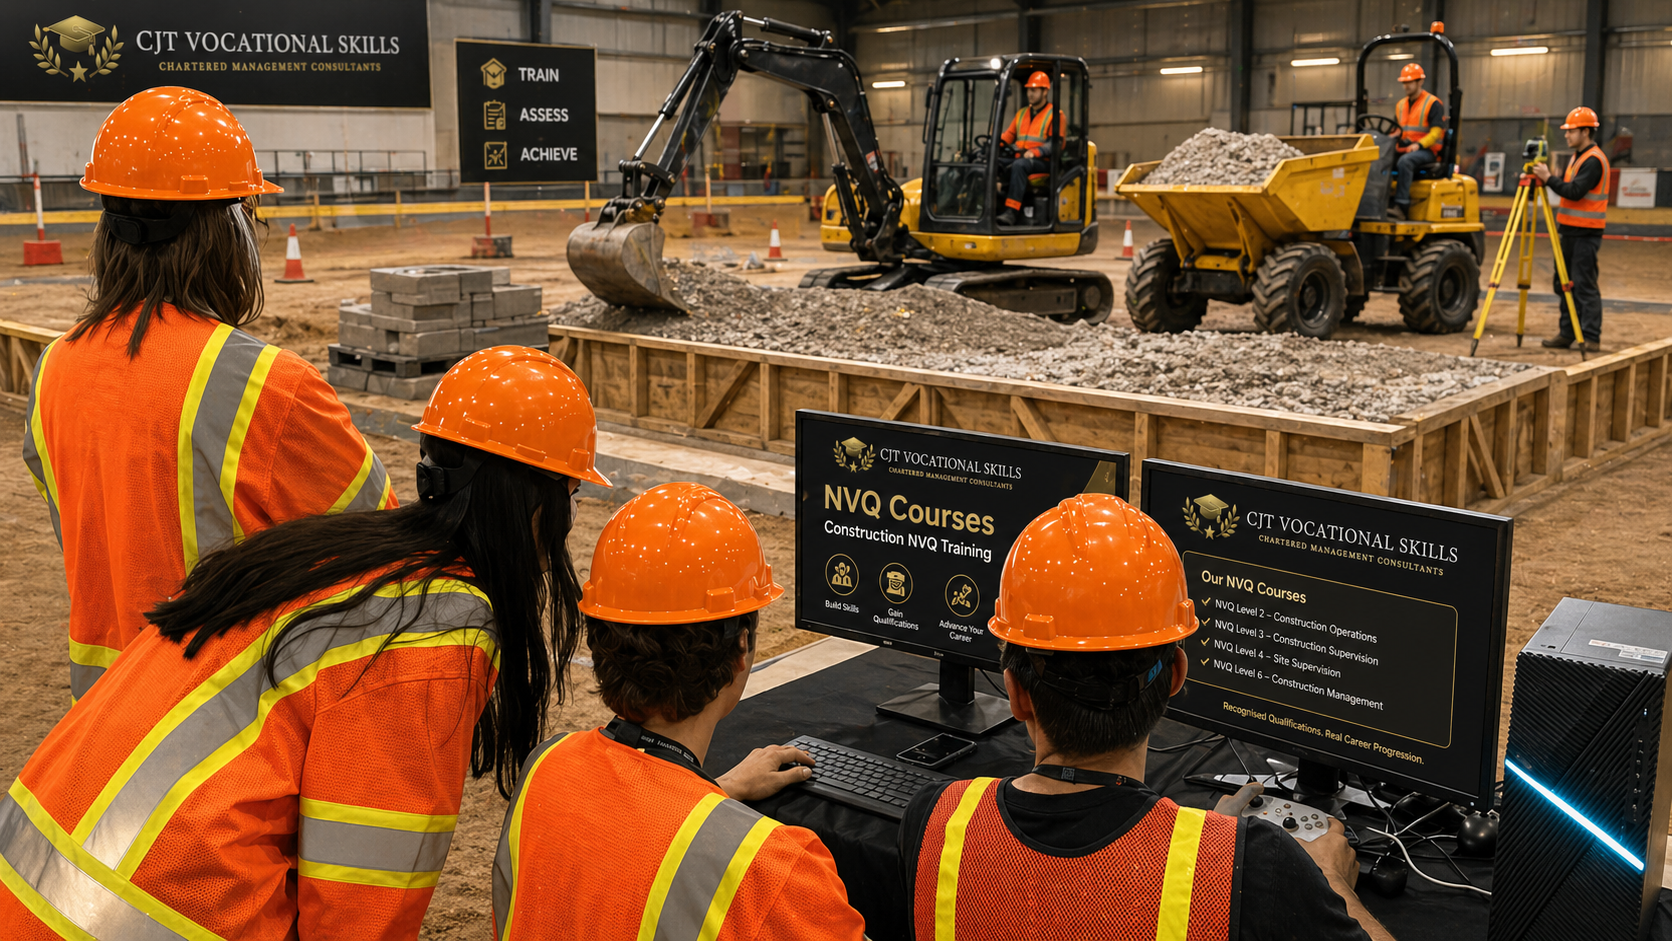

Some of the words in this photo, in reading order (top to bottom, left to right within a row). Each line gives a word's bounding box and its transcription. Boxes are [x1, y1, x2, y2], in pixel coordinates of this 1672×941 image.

[136, 30, 178, 55] CJT
[185, 32, 333, 54] VOCATIONAL
[338, 35, 400, 54] SKILLS
[159, 61, 227, 71] CHARTERED
[232, 62, 307, 71] MANAGEMENT
[311, 63, 381, 71] CONSULTANTS
[518, 68, 559, 83] TRAIN
[520, 107, 569, 122] ASSESS
[520, 147, 577, 161] ACHIEVE
[880, 448, 900, 463] CJT
[903, 451, 981, 474] VOCATIONAL
[984, 462, 1022, 479] SKILLS
[889, 466, 924, 477] CHARTERED
[926, 472, 968, 484] MANAGEMENT
[824, 484, 881, 519] NVQ
[889, 494, 995, 536] Courses
[824, 520, 904, 546] Construction
[908, 536, 938, 552] NVQ
[941, 539, 992, 563] Training
[1246, 511, 1274, 529] CJT
[1279, 516, 1394, 551] VOCATIONAL
[1399, 538, 1458, 563] SKILLS
[1259, 535, 1307, 550] CHARTERED
[1310, 544, 1374, 563] MANAGEMENT
[1377, 556, 1444, 576] CONSULTANTS
[1201, 570, 1223, 585] Our
[1226, 575, 1254, 592] NVQ
[1257, 582, 1307, 604] Courses
[825, 600, 842, 610] Build
[843, 603, 859, 613] Skills
[888, 608, 903, 618] Gain
[873, 615, 919, 630] Qualifications
[939, 620, 968, 632] Advance
[1215, 599, 1234, 612] NVQ
[1236, 603, 1258, 617] Level
[1259, 609, 1265, 618] 2
[1273, 612, 1327, 632] Construction
[1329, 624, 1378, 644] Operations
[949, 632, 972, 643] Career
[1215, 619, 1234, 632] NVQ
[1236, 623, 1257, 637] Level
[1259, 629, 1264, 638] 3
[1273, 633, 1327, 653] Construction
[1329, 646, 1379, 665] Supervision
[1214, 639, 1233, 652] NVQ
[1235, 644, 1256, 658] Level
[1258, 650, 1264, 659] 4
[1273, 653, 1290, 666] Site
[1291, 659, 1341, 678] Supervision
[1214, 659, 1233, 673] NVQ
[1235, 664, 1256, 678] Level
[1257, 670, 1263, 679] 6
[1272, 674, 1325, 695] Construction
[1326, 687, 1384, 710] Management
[1223, 701, 1267, 720] Recognised
[1268, 714, 1323, 736] Qualifications.
[1325, 729, 1343, 742] Real
[1344, 735, 1372, 749] Career
[1373, 743, 1425, 765] Progression.
